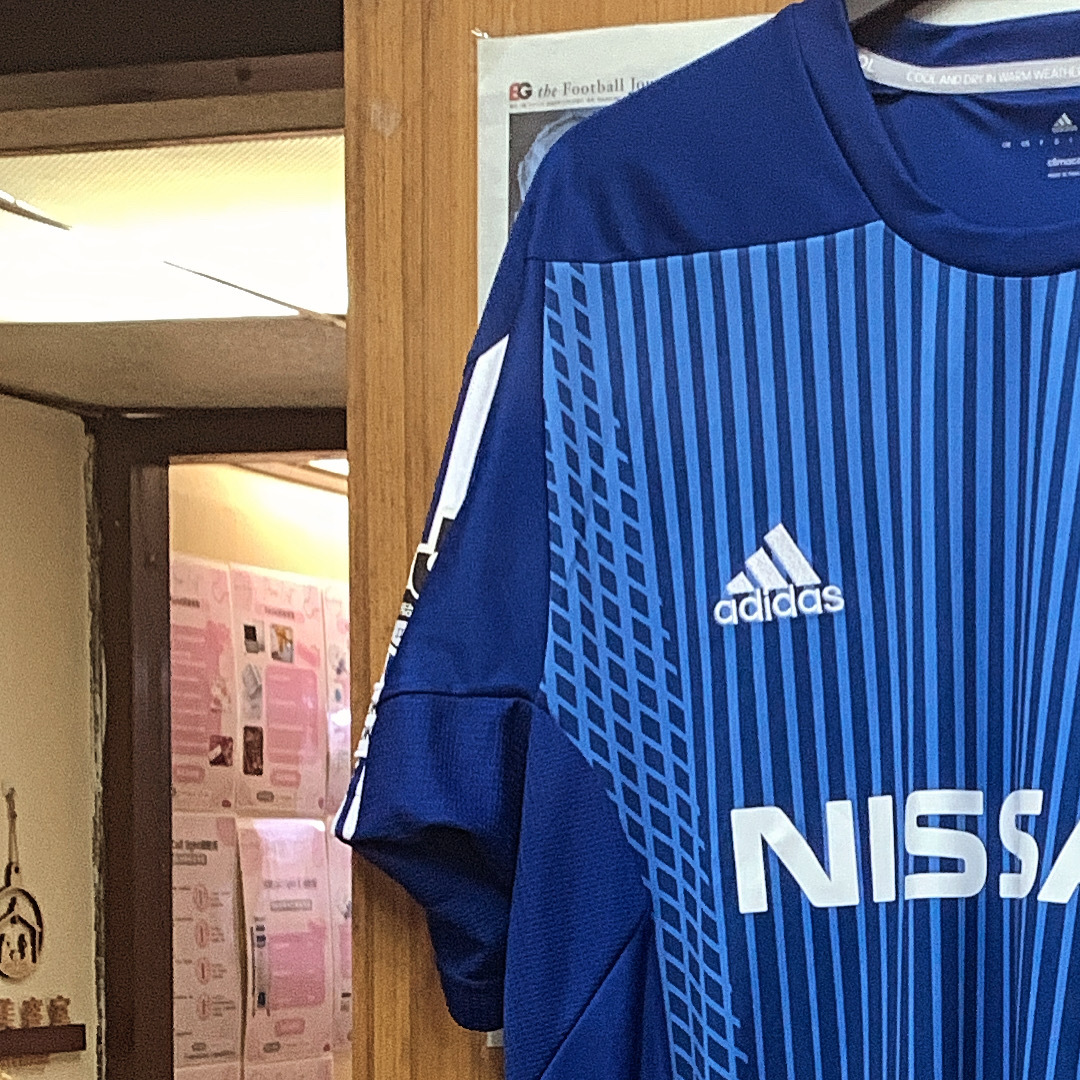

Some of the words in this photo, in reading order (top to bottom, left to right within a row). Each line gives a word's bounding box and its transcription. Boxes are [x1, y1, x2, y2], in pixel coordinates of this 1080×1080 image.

[906, 71, 936, 84] COOL
[939, 74, 962, 85] AND
[963, 74, 983, 85] DRY
[985, 73, 997, 84] IN
[999, 69, 1032, 83] WARM
[538, 84, 557, 98] the
[563, 78, 624, 96] Football
[713, 583, 845, 626] adidas
